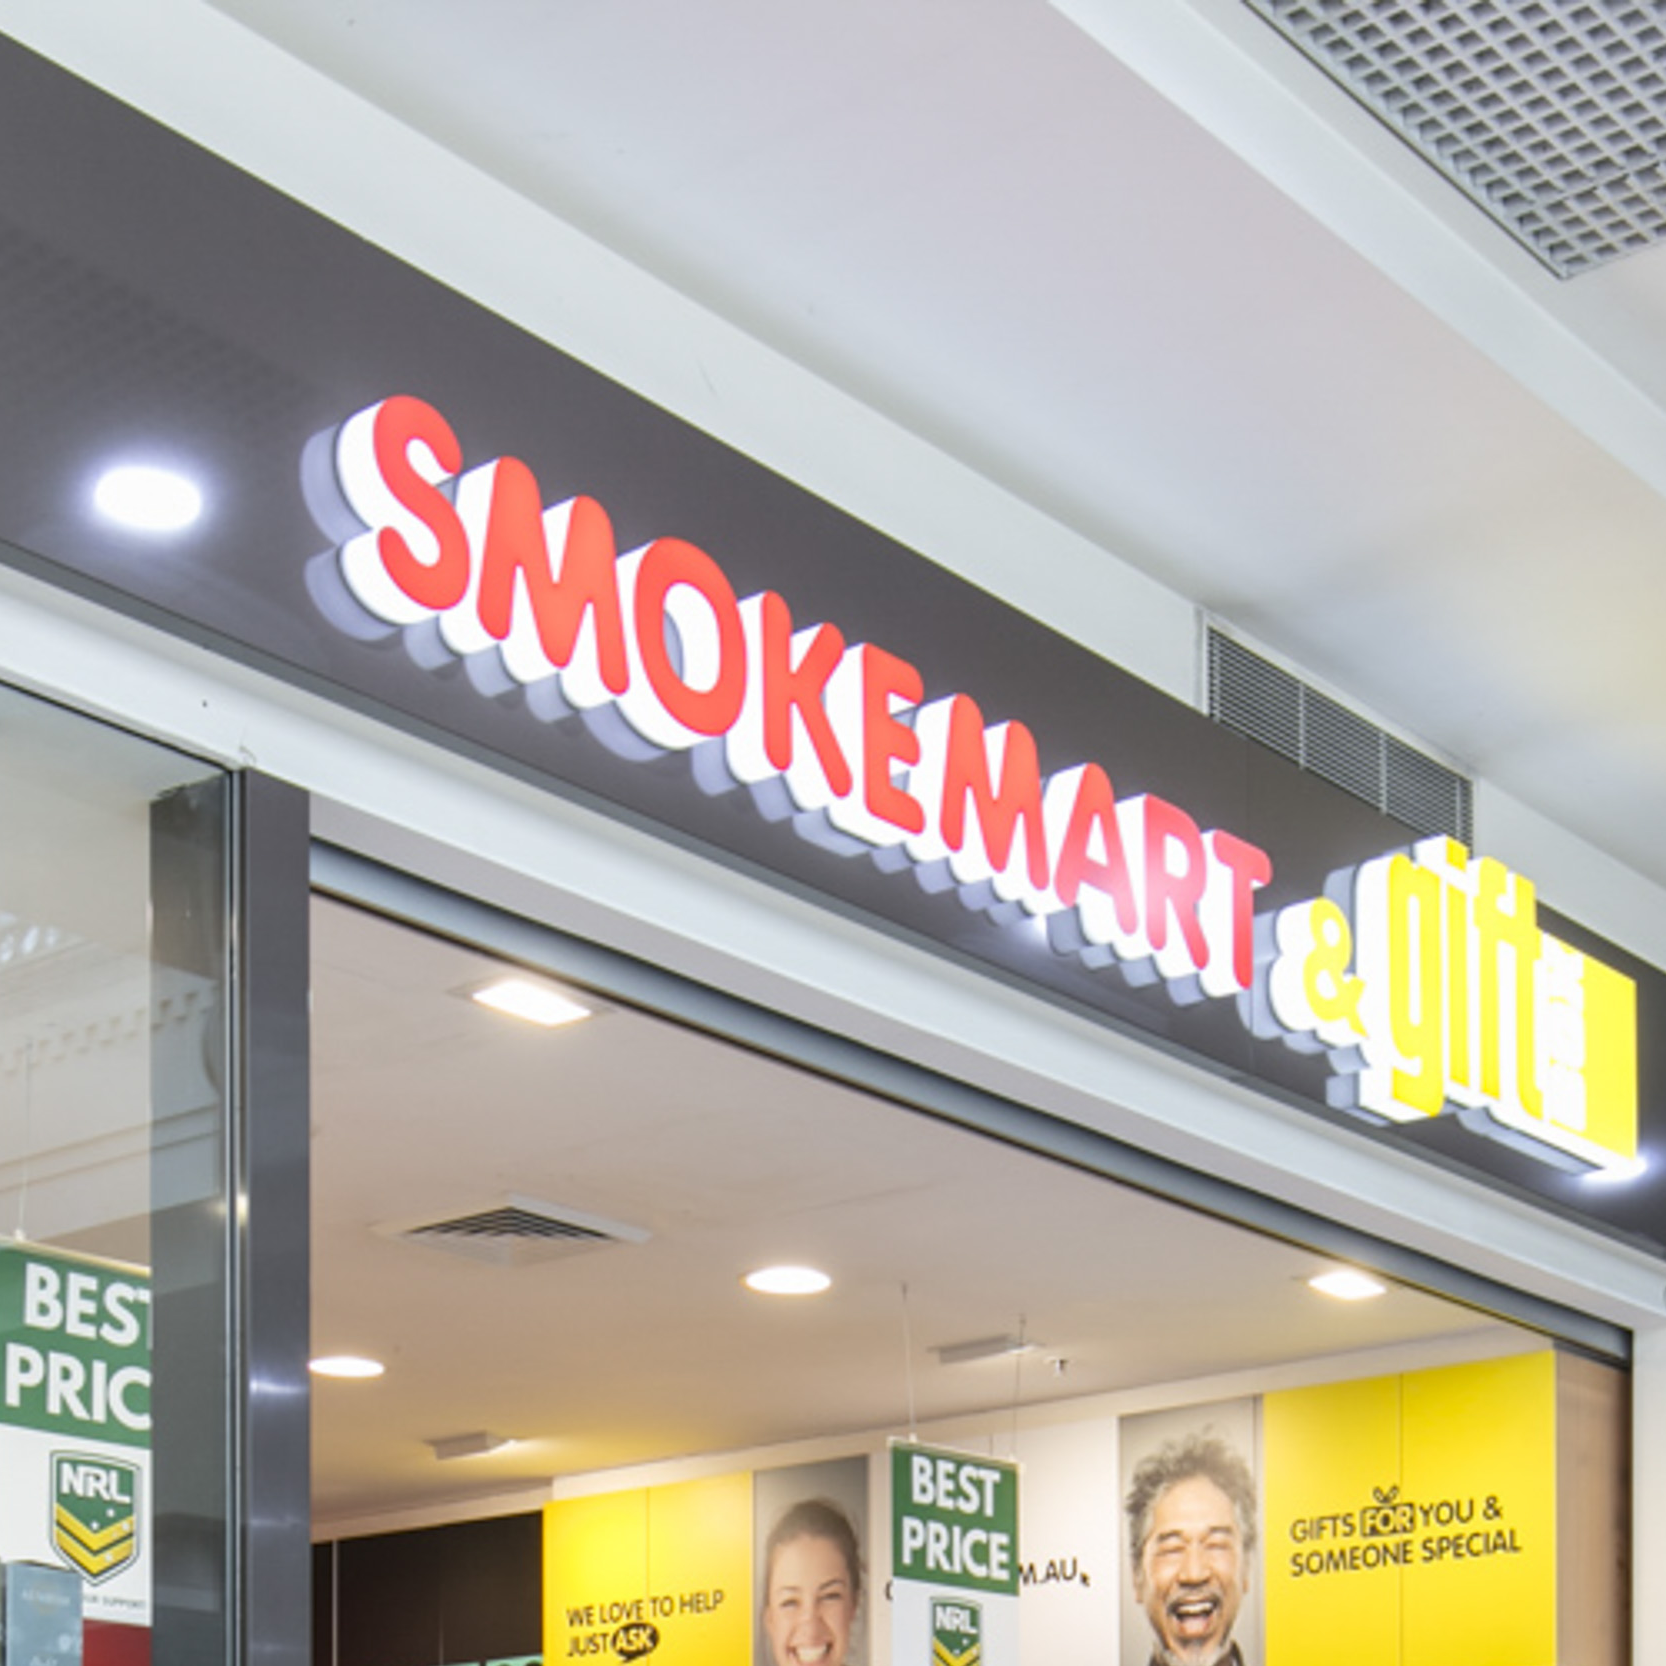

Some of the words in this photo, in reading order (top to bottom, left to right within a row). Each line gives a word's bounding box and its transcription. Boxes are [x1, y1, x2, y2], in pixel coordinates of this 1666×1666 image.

[363, 395, 1272, 990] SMOKEMART
[1303, 897, 1369, 1038] &
[1389, 835, 1542, 1119] gift
[60, 1461, 131, 1504] NRL
[911, 1454, 1001, 1518] BEST
[1290, 1512, 1357, 1543] GIFTS
[1362, 1503, 1414, 1537] FOR
[1419, 1498, 1475, 1527] YOU
[1482, 1495, 1503, 1521] &
[902, 1516, 1011, 1581] PRICE
[1291, 1540, 1414, 1578] SOMEONE
[1421, 1528, 1522, 1563] SPECIAL
[565, 1605, 594, 1627] WE
[598, 1598, 644, 1625] LOVE
[649, 1595, 674, 1618] TO
[679, 1589, 725, 1614] HELP
[934, 1605, 978, 1634] NRL
[566, 1632, 611, 1658] JUST
[615, 1627, 655, 1651] ASK
